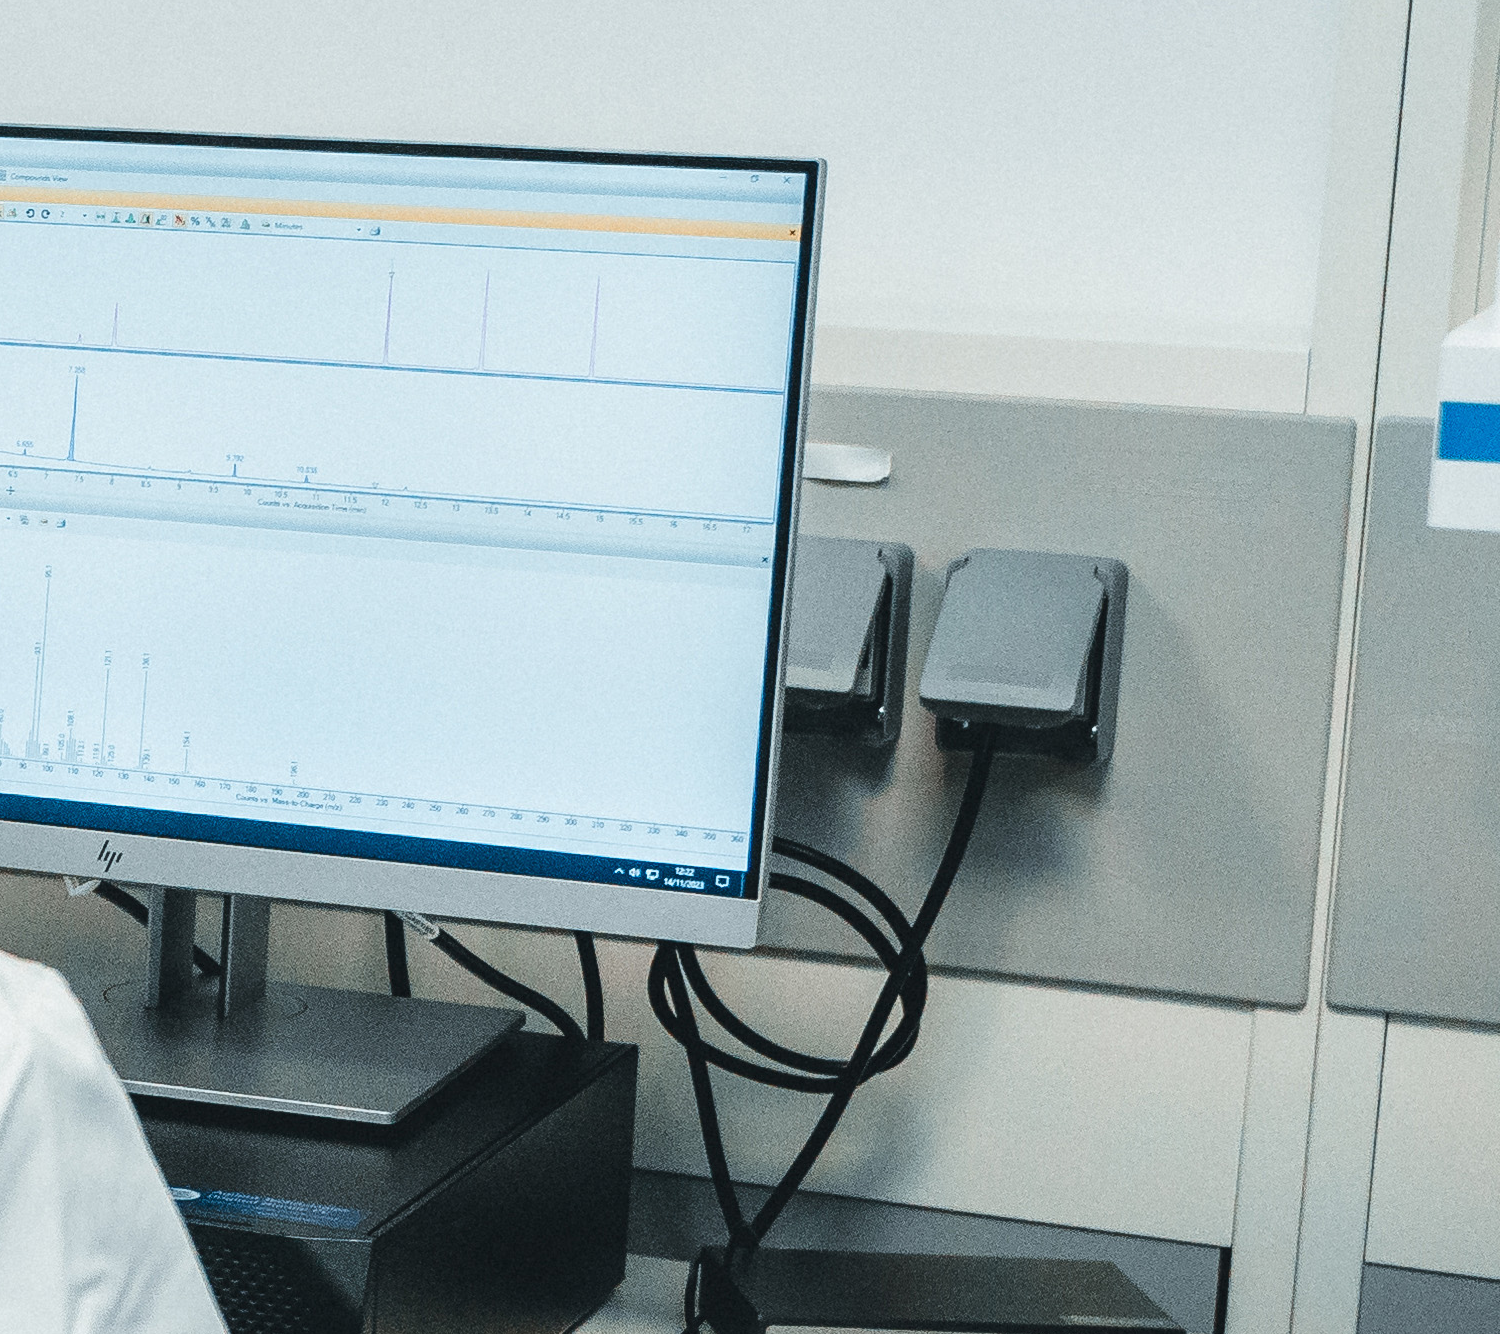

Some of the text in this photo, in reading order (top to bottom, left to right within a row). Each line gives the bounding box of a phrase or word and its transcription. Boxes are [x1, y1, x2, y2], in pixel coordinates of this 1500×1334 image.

[10, 173, 69, 183] Compounds View
[293, 501, 330, 511] Acquisition
[332, 503, 348, 513] Time
[97, 839, 123, 873] hp
[675, 866, 695, 877] 12:22
